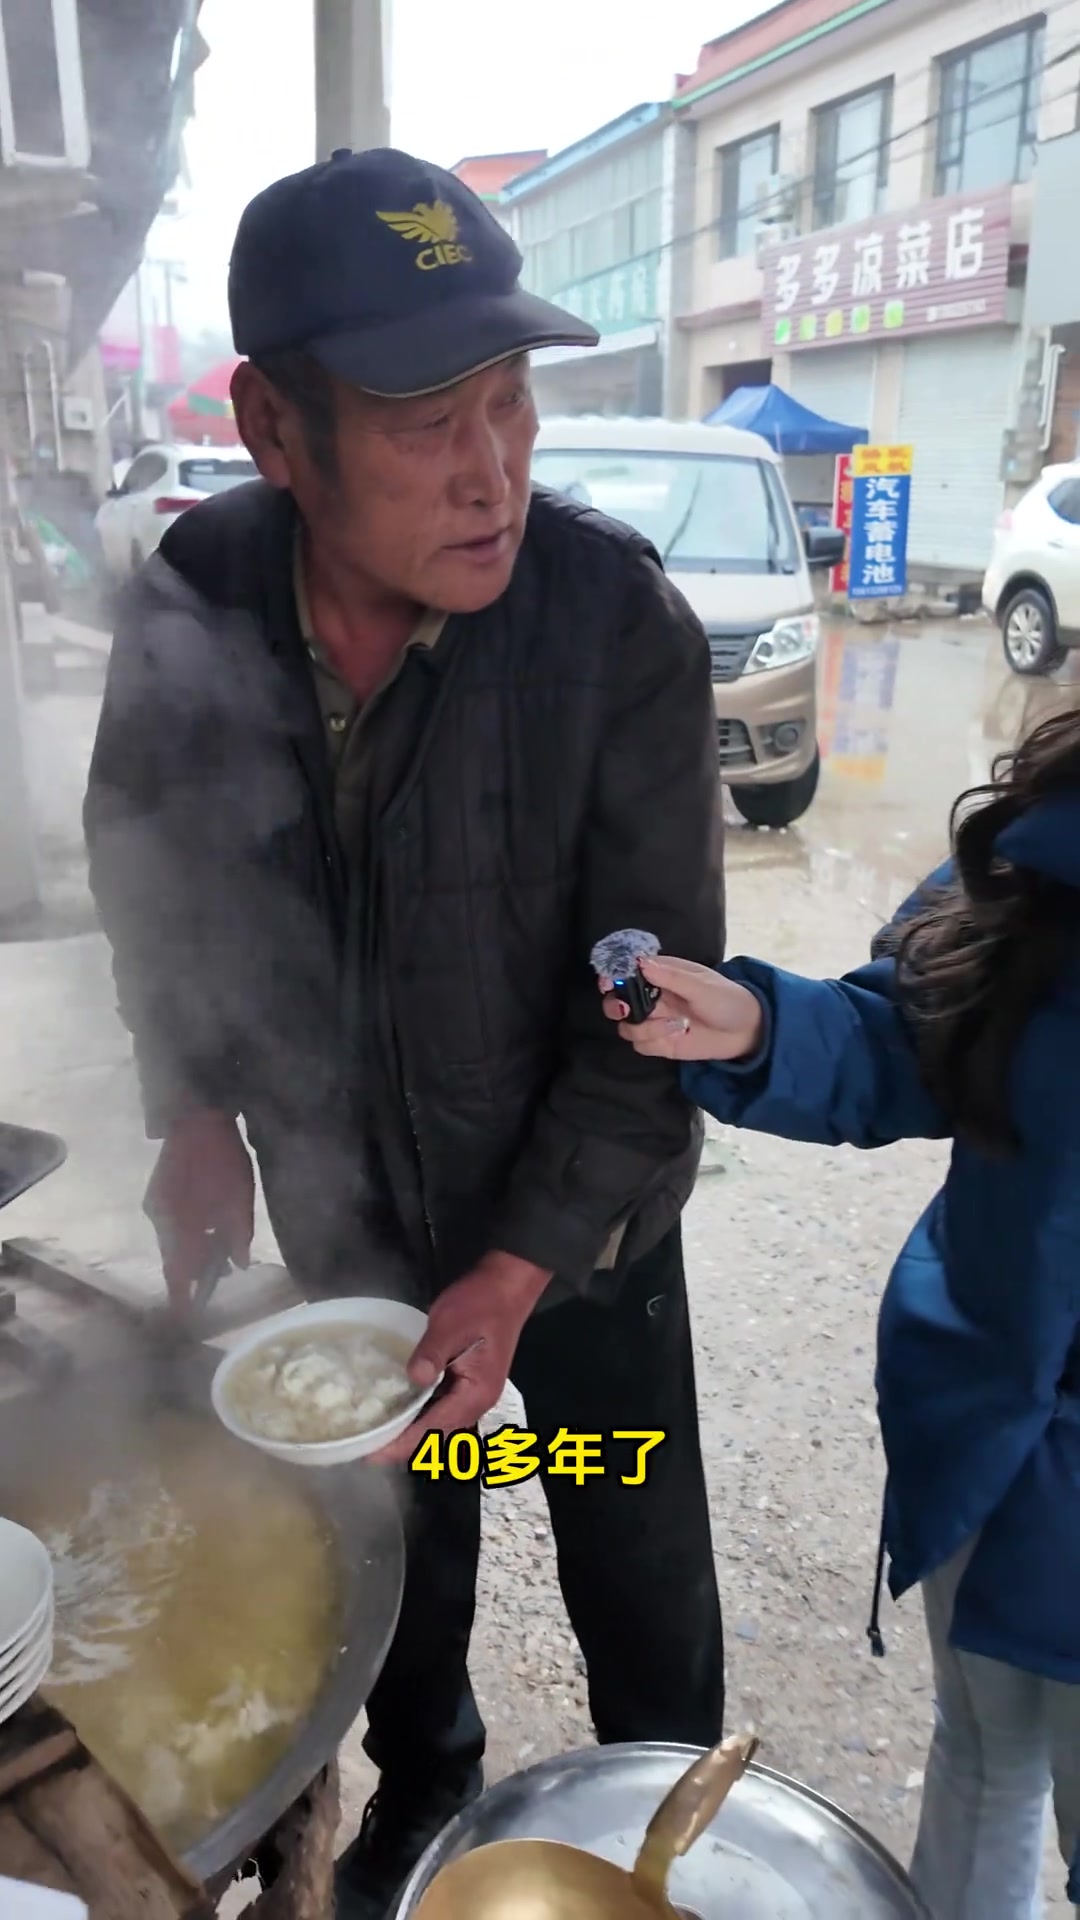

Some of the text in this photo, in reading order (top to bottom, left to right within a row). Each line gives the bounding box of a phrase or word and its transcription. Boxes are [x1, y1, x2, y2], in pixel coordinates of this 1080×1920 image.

[774, 207, 985, 312] 多多凉菜店
[862, 477, 900, 585] 汽车蓄电池
